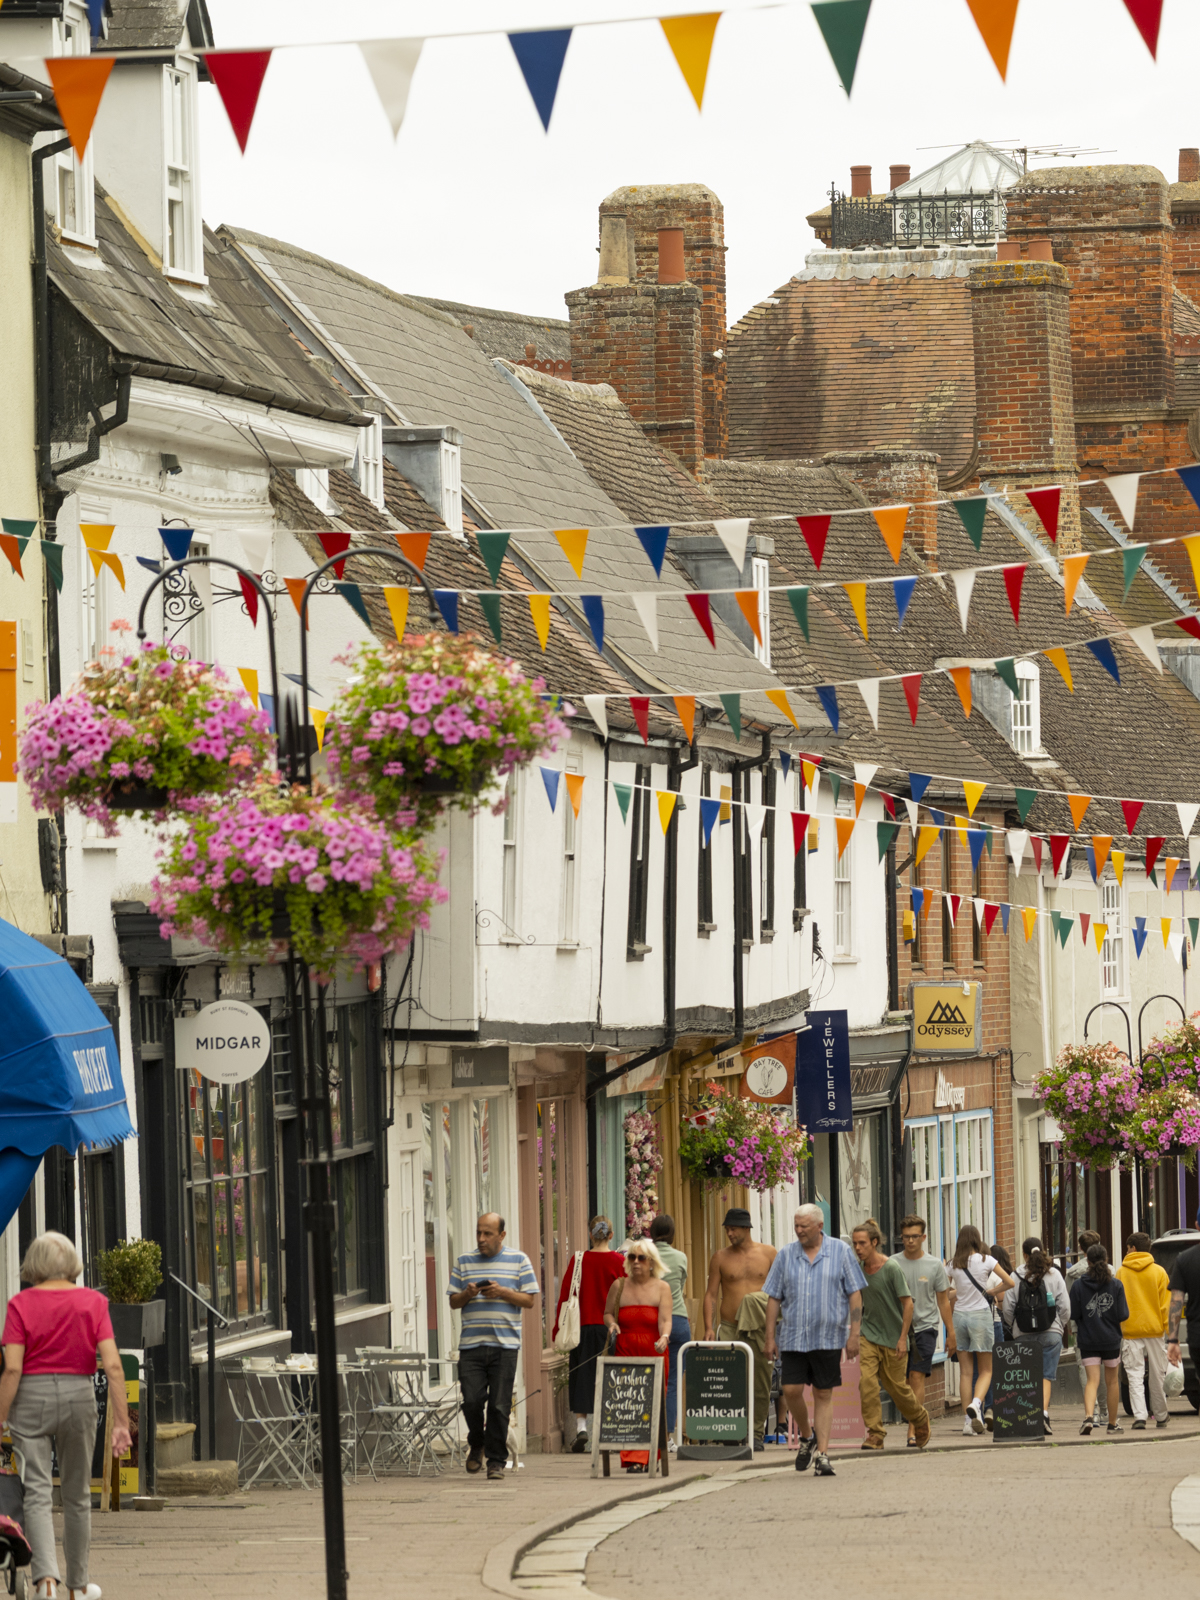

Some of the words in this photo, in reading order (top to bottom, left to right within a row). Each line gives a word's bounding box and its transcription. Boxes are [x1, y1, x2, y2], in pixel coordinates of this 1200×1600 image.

[210, 1008, 221, 1016] BURY
[228, 1006, 248, 1016] EDMUNDS
[918, 1024, 972, 1038] Odyssey
[196, 1036, 261, 1050] MIDGAR
[754, 1058, 766, 1069] BAY
[768, 1058, 782, 1070] TREE
[823, 1017, 836, 1110] JEWELLERS
[996, 1346, 1014, 1358] Bay
[1014, 1342, 1032, 1356] Tree
[1004, 1370, 1030, 1382] OPEN
[638, 1386, 646, 1402] &
[605, 1399, 644, 1416] Something
[686, 1405, 746, 1418] oakheart
[615, 1410, 636, 1422] Sweet
[712, 1424, 736, 1432] open
